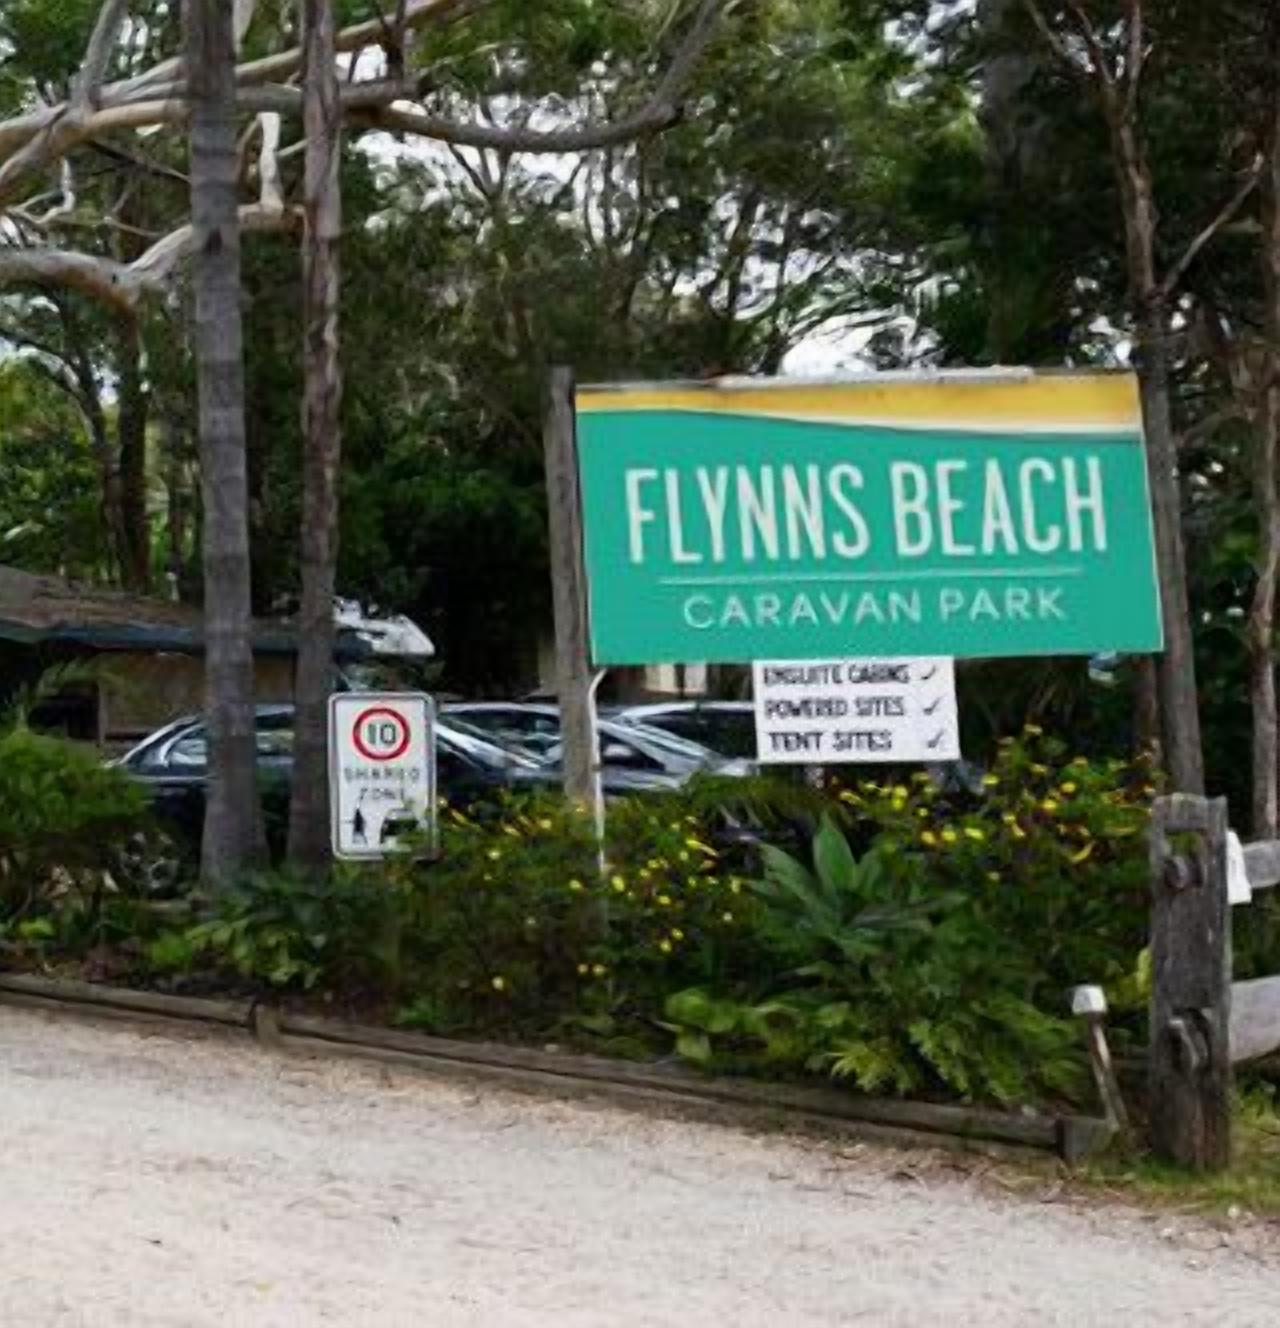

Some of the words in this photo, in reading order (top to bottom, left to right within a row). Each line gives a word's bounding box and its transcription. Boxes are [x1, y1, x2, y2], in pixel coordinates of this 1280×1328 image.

[624, 463, 871, 564] FLYNNS
[889, 456, 1107, 557] BEACH
[683, 589, 921, 629] CARAVAN
[940, 587, 1064, 622] PARK
[763, 664, 843, 684] ENSUITE
[848, 663, 911, 684] CABINS
[764, 696, 848, 719] POWERED
[855, 695, 905, 717] SITES
[366, 723, 397, 746] 10
[768, 730, 824, 751] TENT
[832, 729, 892, 751] SITES
[343, 767, 421, 783] SHARED
